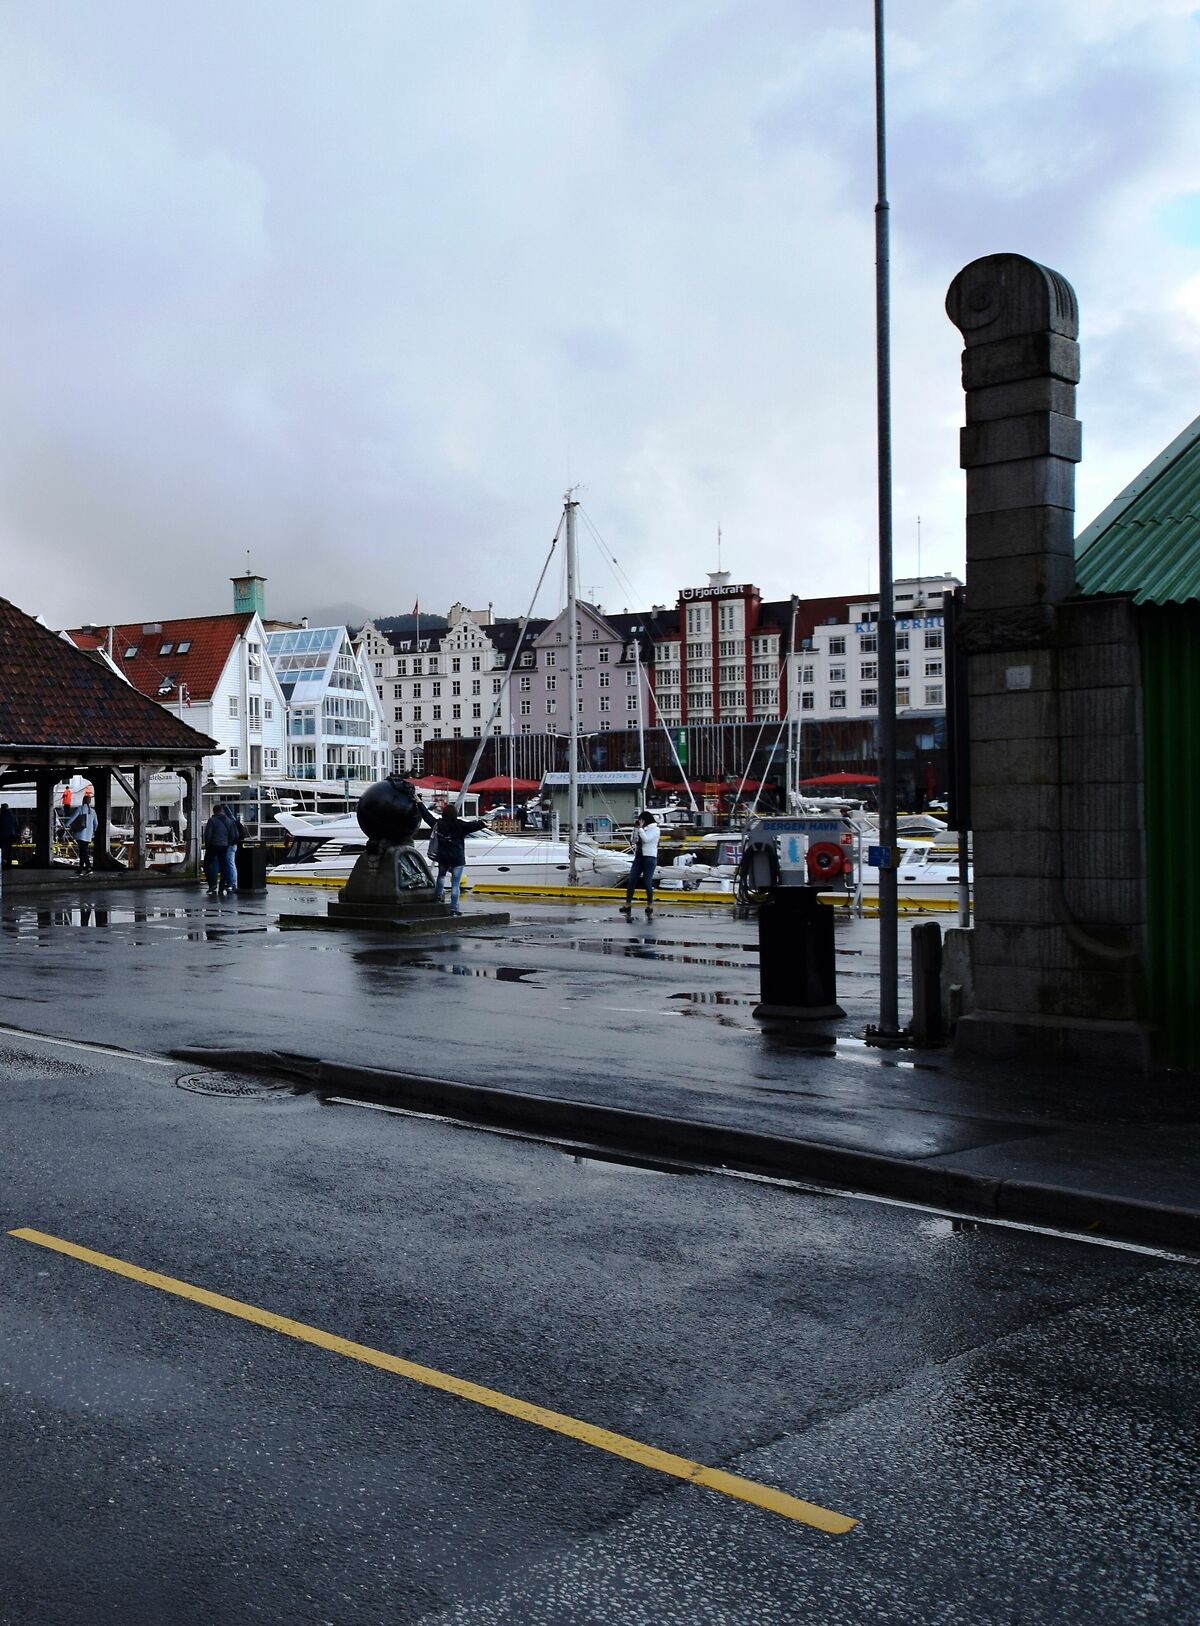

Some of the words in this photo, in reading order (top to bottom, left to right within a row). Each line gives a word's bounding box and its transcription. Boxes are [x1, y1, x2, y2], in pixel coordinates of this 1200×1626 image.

[695, 585, 744, 598] Fjordkraft
[855, 616, 944, 632] KLERHU
[405, 721, 429, 729] Scandic
[589, 772, 638, 780] CRUISES
[763, 821, 805, 831] BERGEN
[810, 821, 838, 831] HAVN
